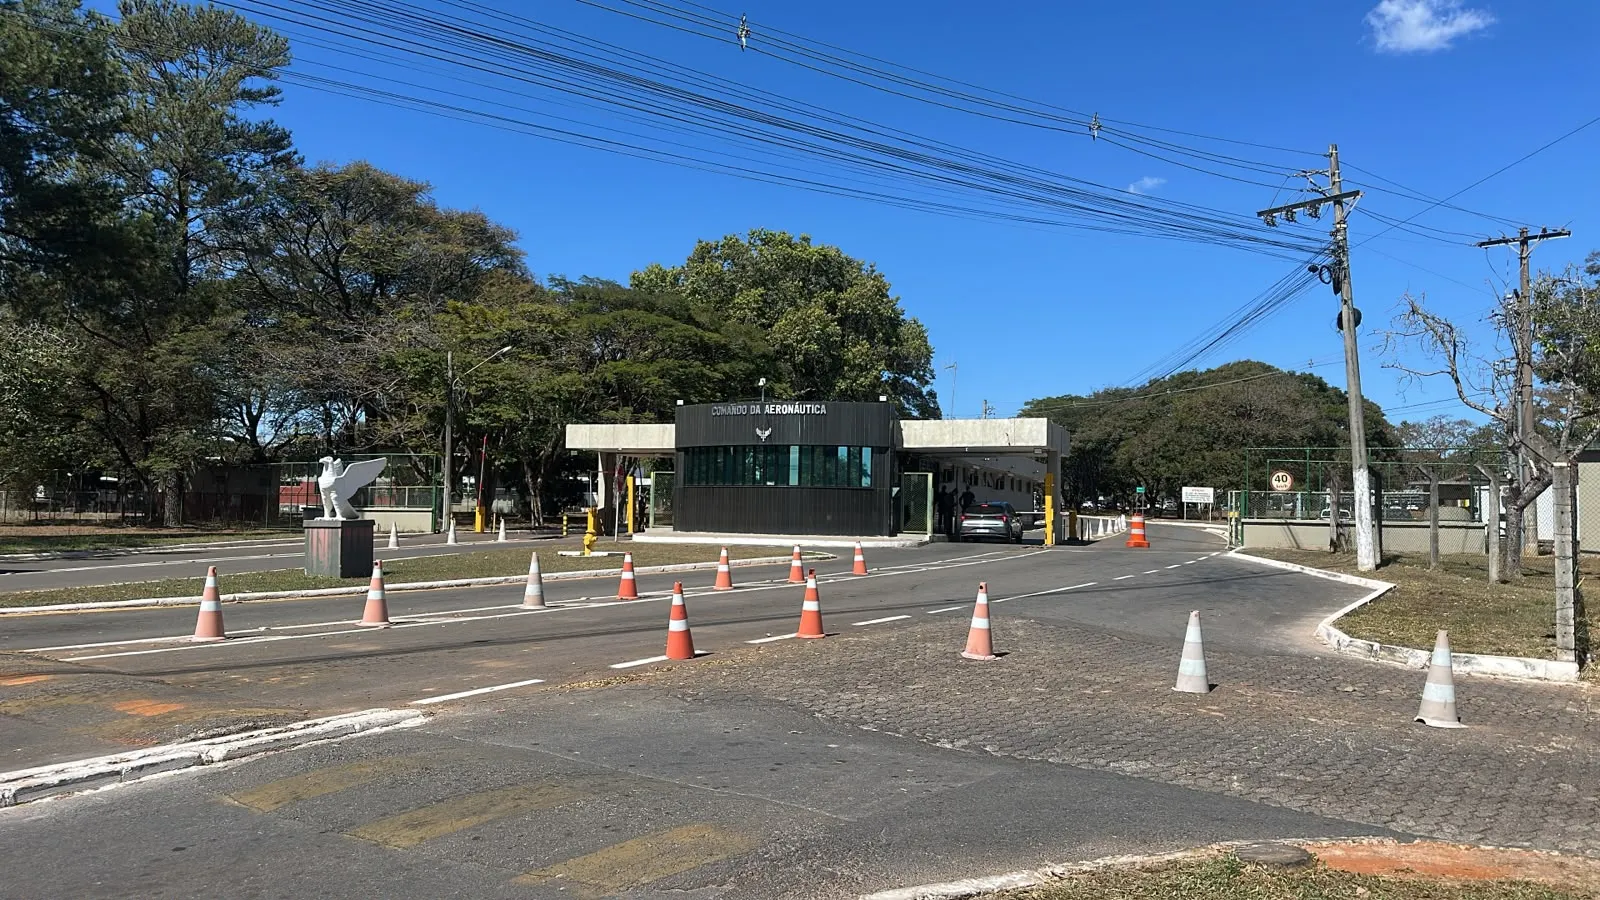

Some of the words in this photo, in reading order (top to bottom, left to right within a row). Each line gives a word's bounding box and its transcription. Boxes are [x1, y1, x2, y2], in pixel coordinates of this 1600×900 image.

[711, 404, 747, 416] COMANDO
[750, 404, 761, 415] DA
[764, 402, 827, 415] AERONÁUTICA
[1274, 474, 1288, 483] 40
